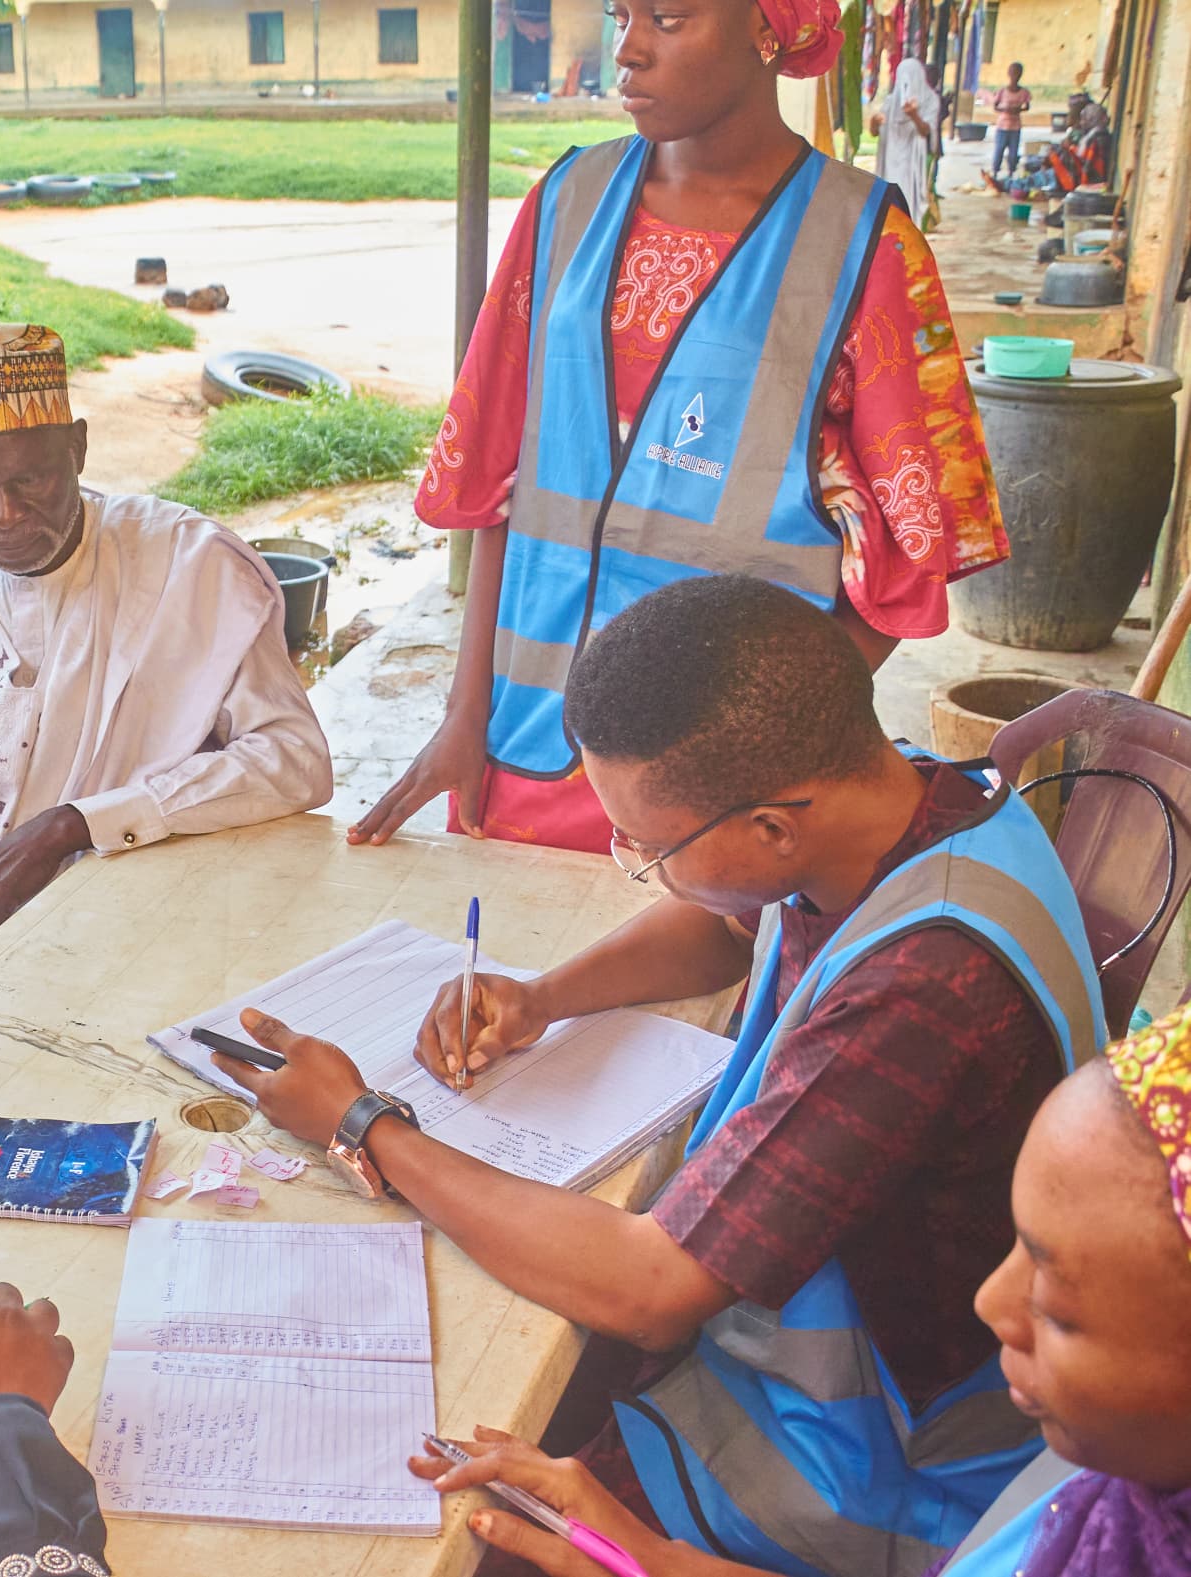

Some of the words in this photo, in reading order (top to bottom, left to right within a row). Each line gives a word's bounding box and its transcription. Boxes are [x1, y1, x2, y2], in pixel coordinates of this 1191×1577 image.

[647, 443, 679, 466] ASPIRE
[678, 453, 724, 479] ALLIANCE
[7, 1147, 31, 1179] Florence
[22, 1150, 45, 1174] Ishaya
